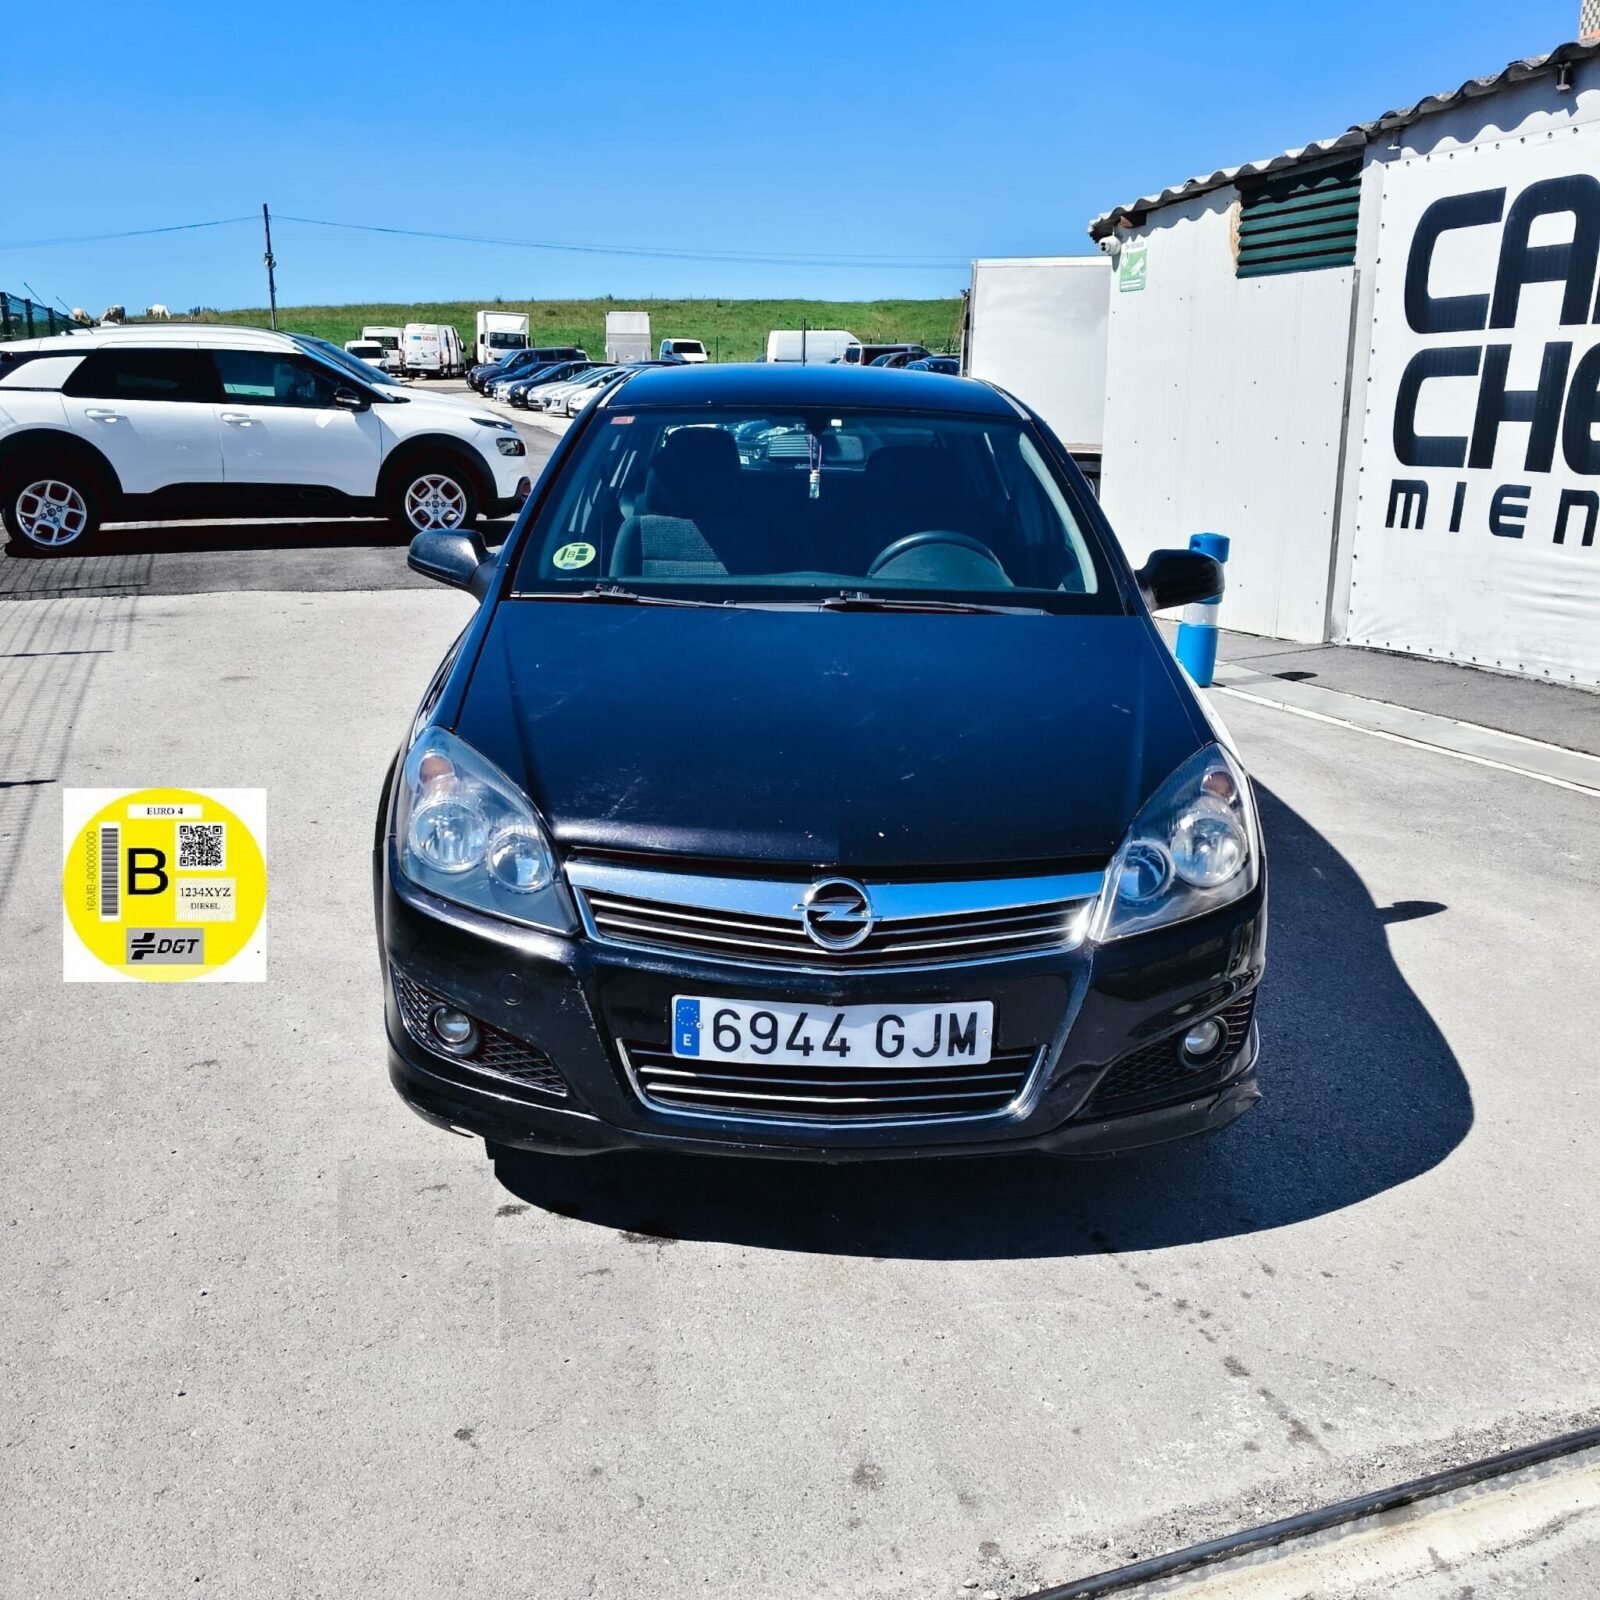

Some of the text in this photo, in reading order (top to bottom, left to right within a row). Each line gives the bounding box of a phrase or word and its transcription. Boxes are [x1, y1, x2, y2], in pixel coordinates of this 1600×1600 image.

[1404, 174, 1600, 334] CA
[683, 1034, 692, 1047] E
[712, 1008, 978, 1059] 6944 GJM
